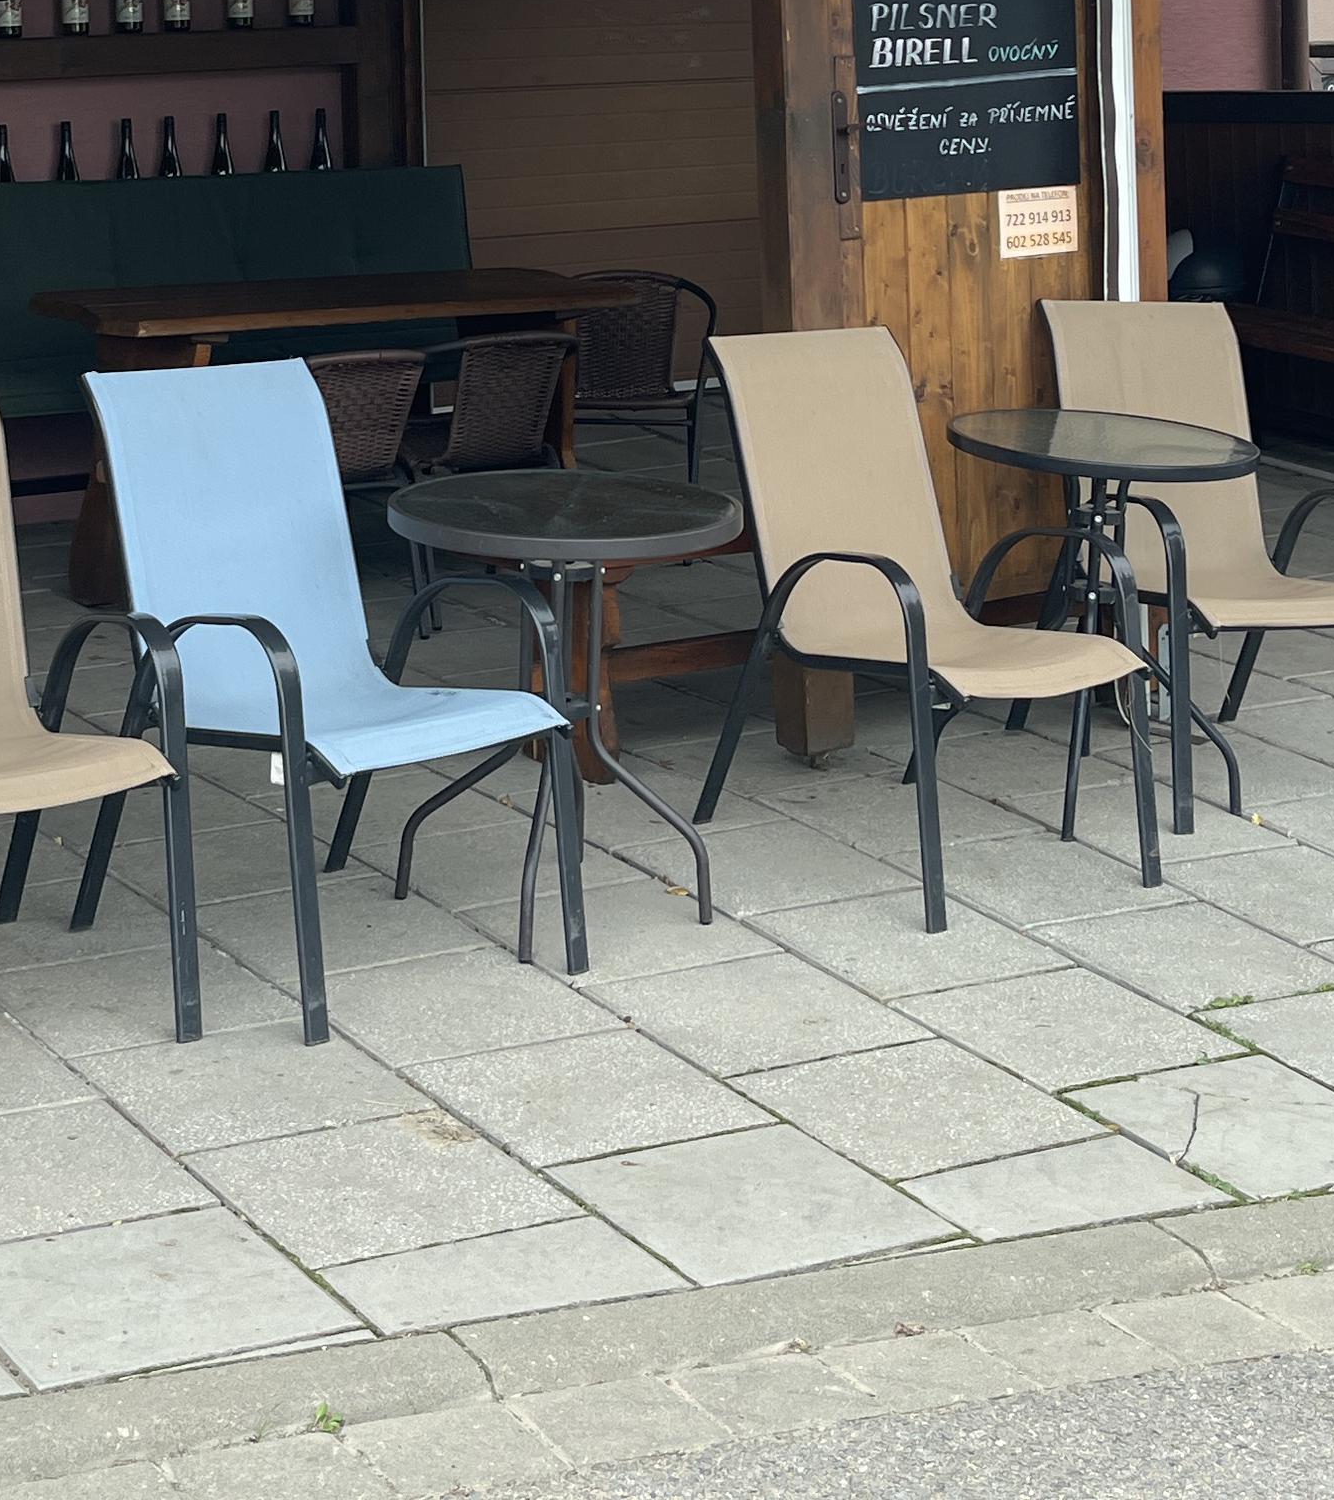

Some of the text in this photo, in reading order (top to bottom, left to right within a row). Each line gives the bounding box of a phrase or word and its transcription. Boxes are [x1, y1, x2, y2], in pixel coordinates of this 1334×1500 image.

[869, 2, 998, 32] PILSNER
[868, 37, 979, 68] BIRELL
[958, 111, 979, 129] ZA
[987, 94, 1077, 125] PŘÍJEMNÉ
[1005, 208, 1072, 227] 722 914 913
[1006, 230, 1073, 250] 602 528 545
